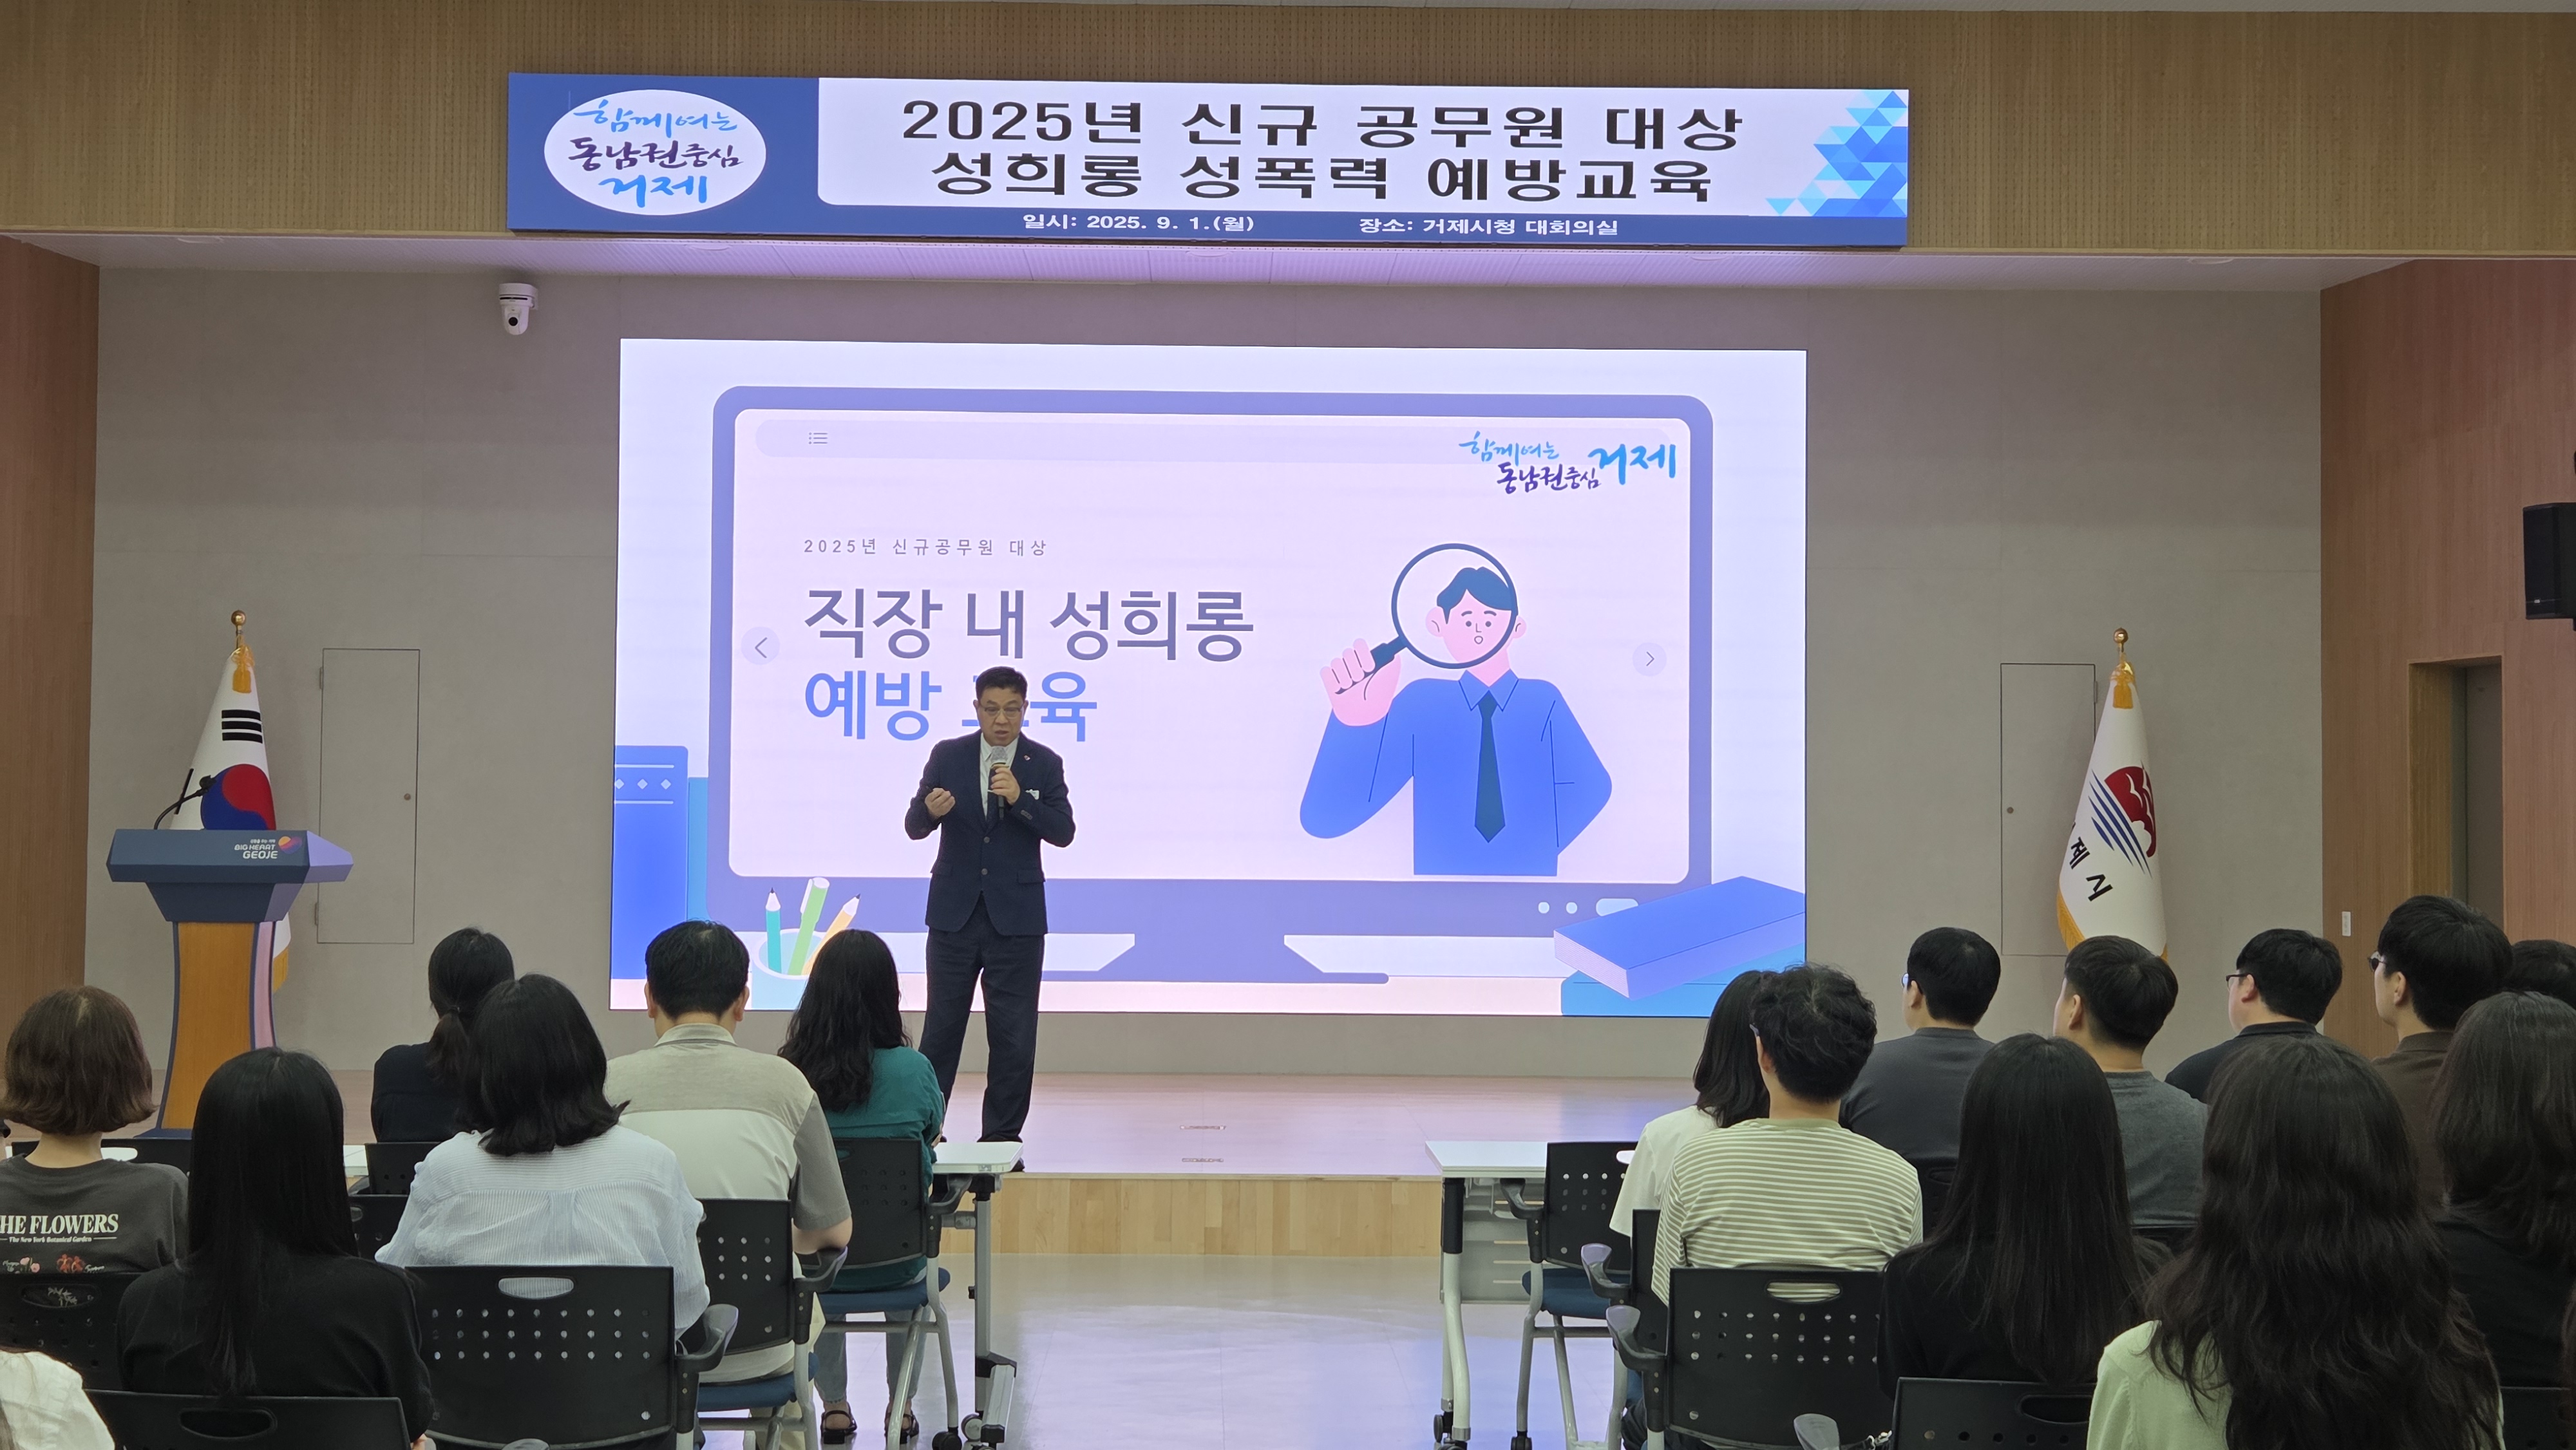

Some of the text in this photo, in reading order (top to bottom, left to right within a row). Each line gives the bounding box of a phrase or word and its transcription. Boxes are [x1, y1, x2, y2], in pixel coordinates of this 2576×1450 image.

[903, 100, 1743, 151] 2025년 신규 공무원 대상
[598, 174, 708, 208] 거제
[931, 152, 1711, 203] 성희롱 성폭력 예방교육
[1023, 214, 1077, 230] 일시:
[1086, 216, 1147, 229] 2025.
[1157, 216, 1179, 229] 9.
[1359, 218, 1618, 236] 장소: 거제시청 대회의실
[1587, 443, 1676, 485] 거제
[804, 538, 1047, 556] 2025년 신규공무원 대상
[804, 588, 1254, 663] 직장 내 성희롱
[805, 670, 942, 741] 예방
[243, 851, 278, 859] GEOJE
[2069, 822, 2113, 901] 제시
[0, 1214, 118, 1234] HE FLOWERS
